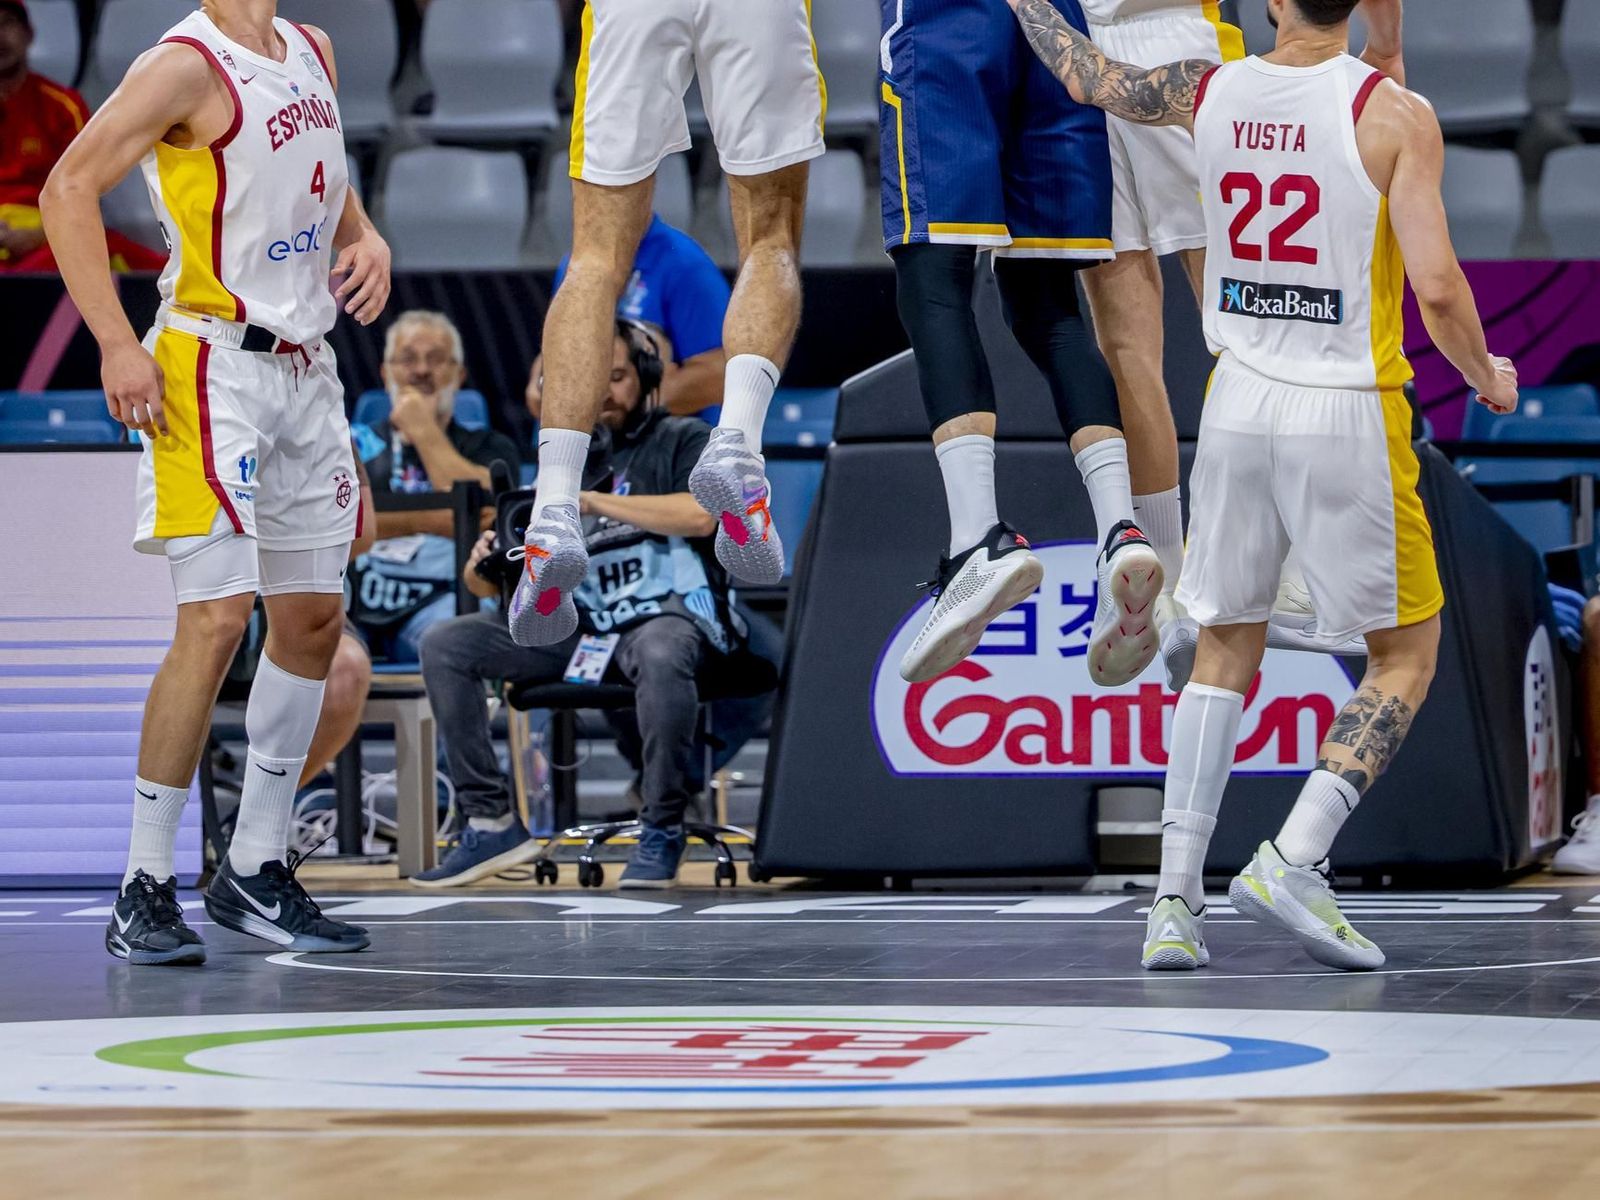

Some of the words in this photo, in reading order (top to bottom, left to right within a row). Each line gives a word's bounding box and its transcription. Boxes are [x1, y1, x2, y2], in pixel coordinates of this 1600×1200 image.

[266, 93, 341, 153] ESPAÑA
[1233, 120, 1306, 152] YUSTA
[310, 160, 326, 203] 4
[1219, 171, 1320, 266] 22
[1241, 285, 1337, 321] CaixaBank
[598, 558, 643, 595] HB
